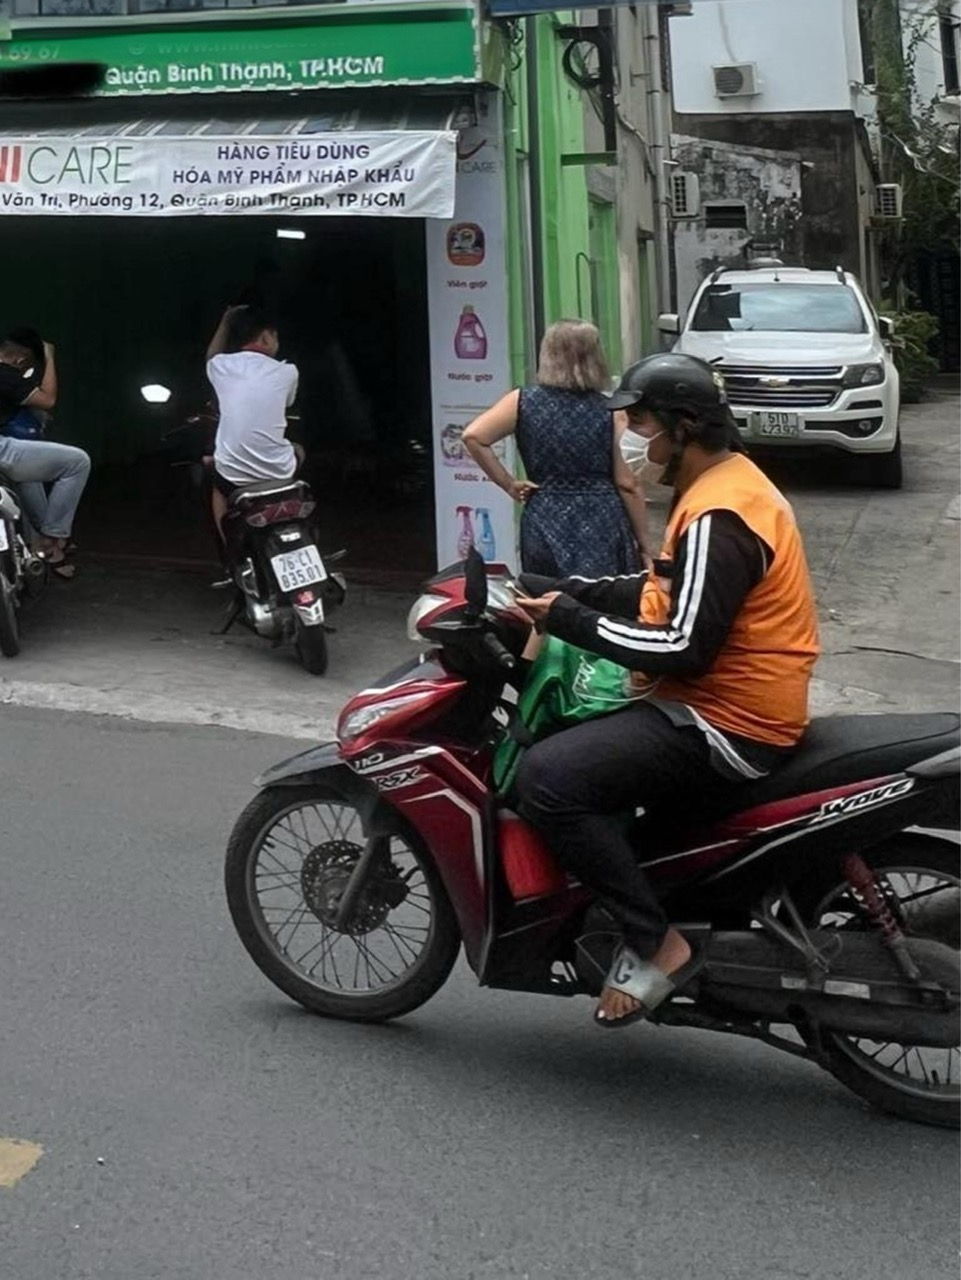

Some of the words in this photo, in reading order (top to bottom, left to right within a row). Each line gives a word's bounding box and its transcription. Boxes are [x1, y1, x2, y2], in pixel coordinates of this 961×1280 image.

[299, 55, 384, 78] TP.HCM
[217, 142, 270, 160] HÀNG
[276, 142, 311, 160] TIÊU
[316, 141, 370, 160] DÙNG
[173, 165, 212, 184] HÓA
[218, 165, 243, 184] MỸ
[140, 192, 164, 209] 12,
